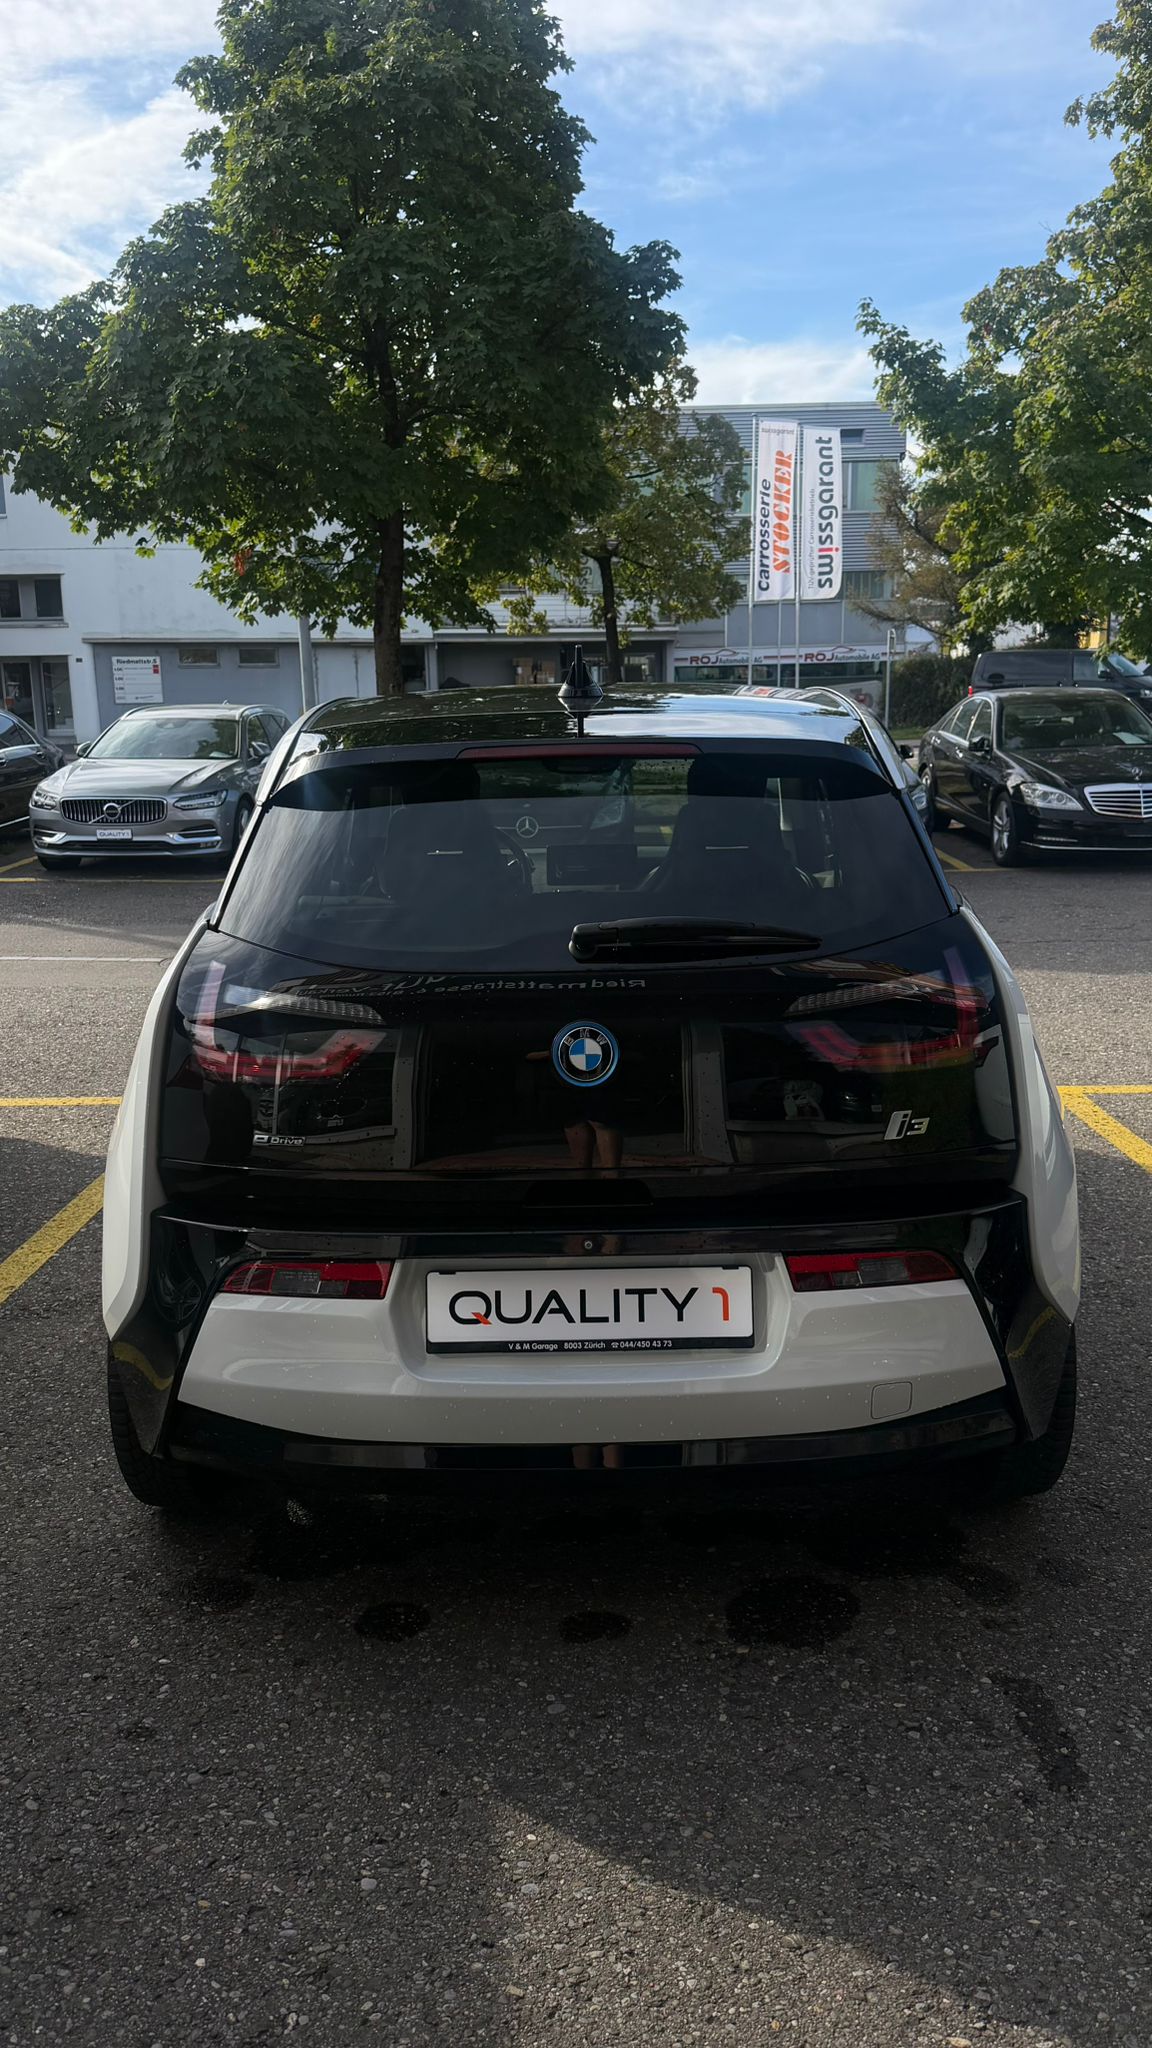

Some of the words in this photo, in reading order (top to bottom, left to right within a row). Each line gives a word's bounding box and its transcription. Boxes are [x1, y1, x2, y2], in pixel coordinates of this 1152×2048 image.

[773, 450, 793, 575] STOCKER
[815, 436, 840, 589] swissgarant
[690, 655, 719, 665] ROJ
[719, 655, 751, 664] Automobil
[804, 652, 835, 662] ROJ
[871, 652, 880, 660] AG
[564, 1028, 608, 1047] BMW
[884, 1110, 930, 1140] i3
[449, 1287, 699, 1325] QUALITY
[712, 1287, 730, 1322] 1
[532, 1342, 558, 1351] Garage
[584, 1341, 606, 1349] Zürich
[619, 1340, 651, 1348] 044/450
[652, 1340, 662, 1348] 43
